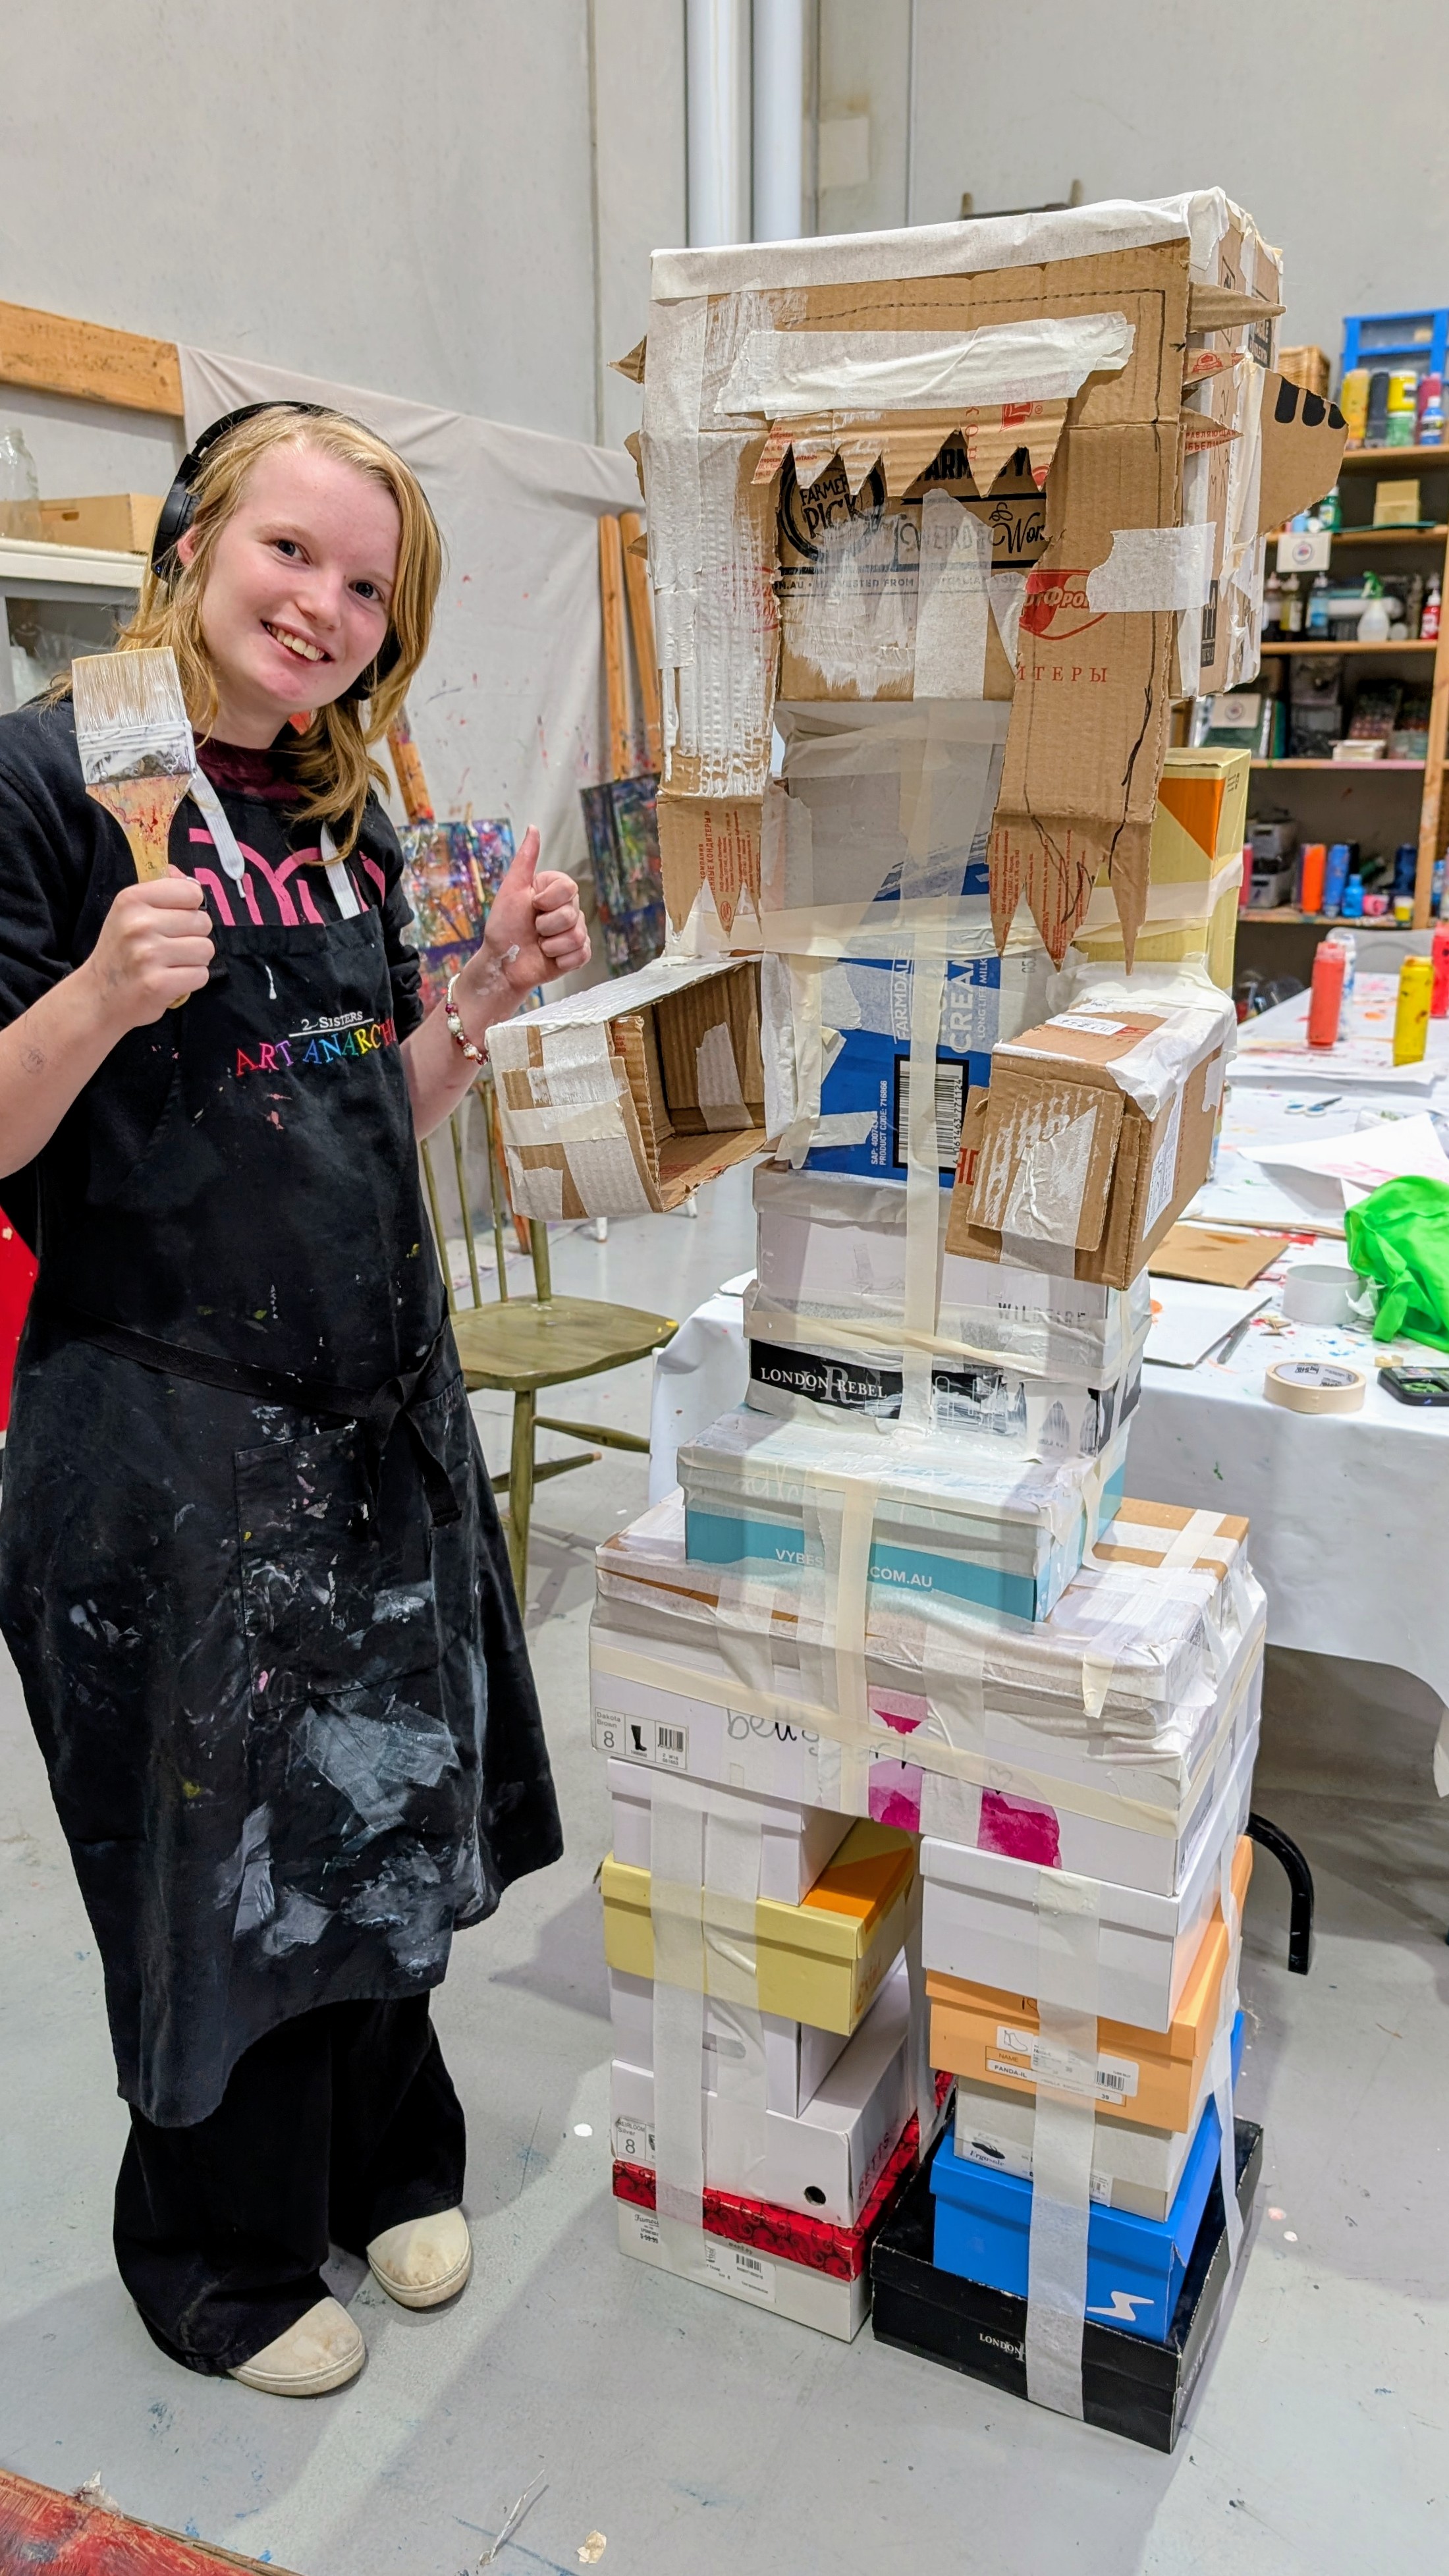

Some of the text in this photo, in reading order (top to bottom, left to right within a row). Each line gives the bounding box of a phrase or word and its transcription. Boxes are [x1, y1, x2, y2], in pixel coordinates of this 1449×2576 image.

[803, 493, 870, 539] PICK
[979, 959, 989, 984] MILK
[977, 1009, 987, 1038] LONG
[236, 1040, 294, 1077] ART
[761, 1367, 888, 1398] LONDON REBEL
[597, 1711, 621, 1722] Dakota
[597, 1718, 617, 1728] Brown
[603, 1730, 615, 1748] 8
[998, 2052, 1020, 2063] NAME
[994, 2064, 1027, 2078] FANDA-IL
[625, 2138, 636, 2154] 8
[979, 2333, 1020, 2354] LONDON
